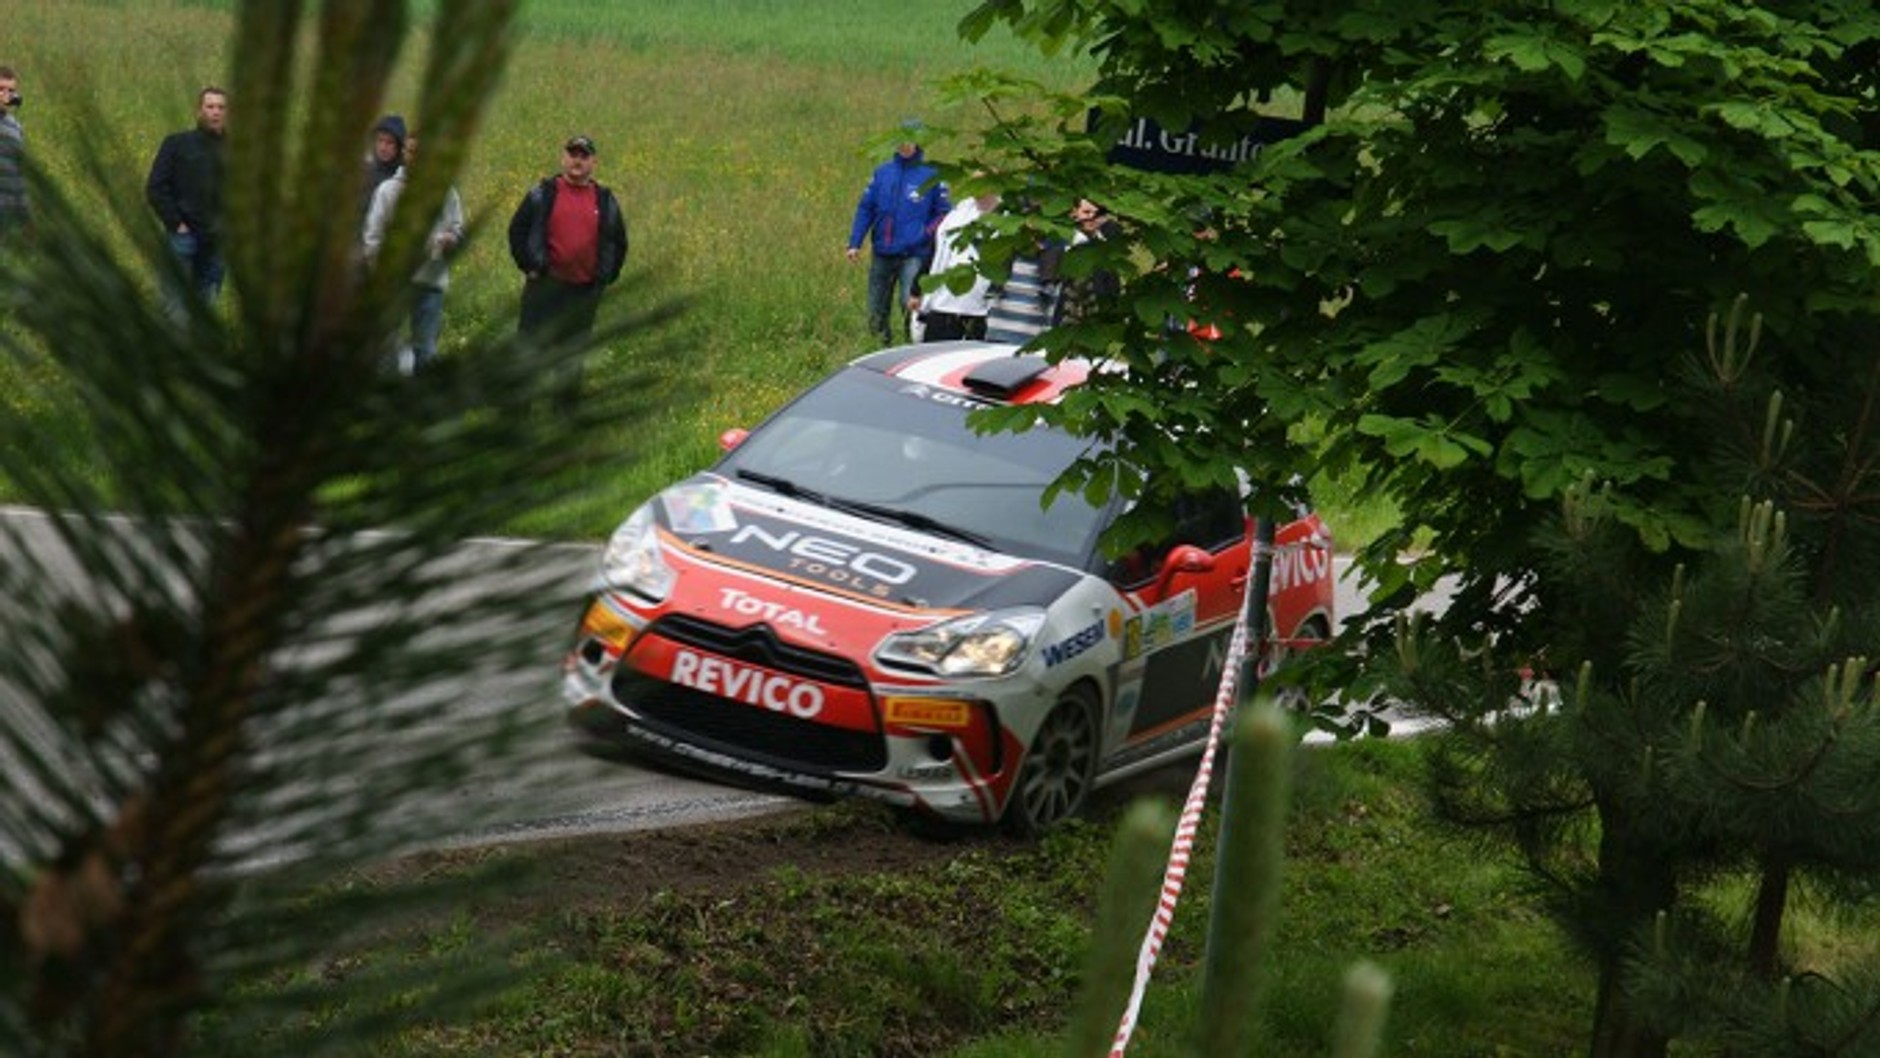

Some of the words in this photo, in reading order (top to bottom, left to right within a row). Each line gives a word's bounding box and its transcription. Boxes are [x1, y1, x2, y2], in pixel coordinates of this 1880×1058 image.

[729, 524, 918, 585] NEO
[787, 556, 892, 597] TOOLS
[1267, 535, 1329, 596] EVICO
[719, 587, 829, 636] TOTAL
[670, 648, 826, 719] REVICO
